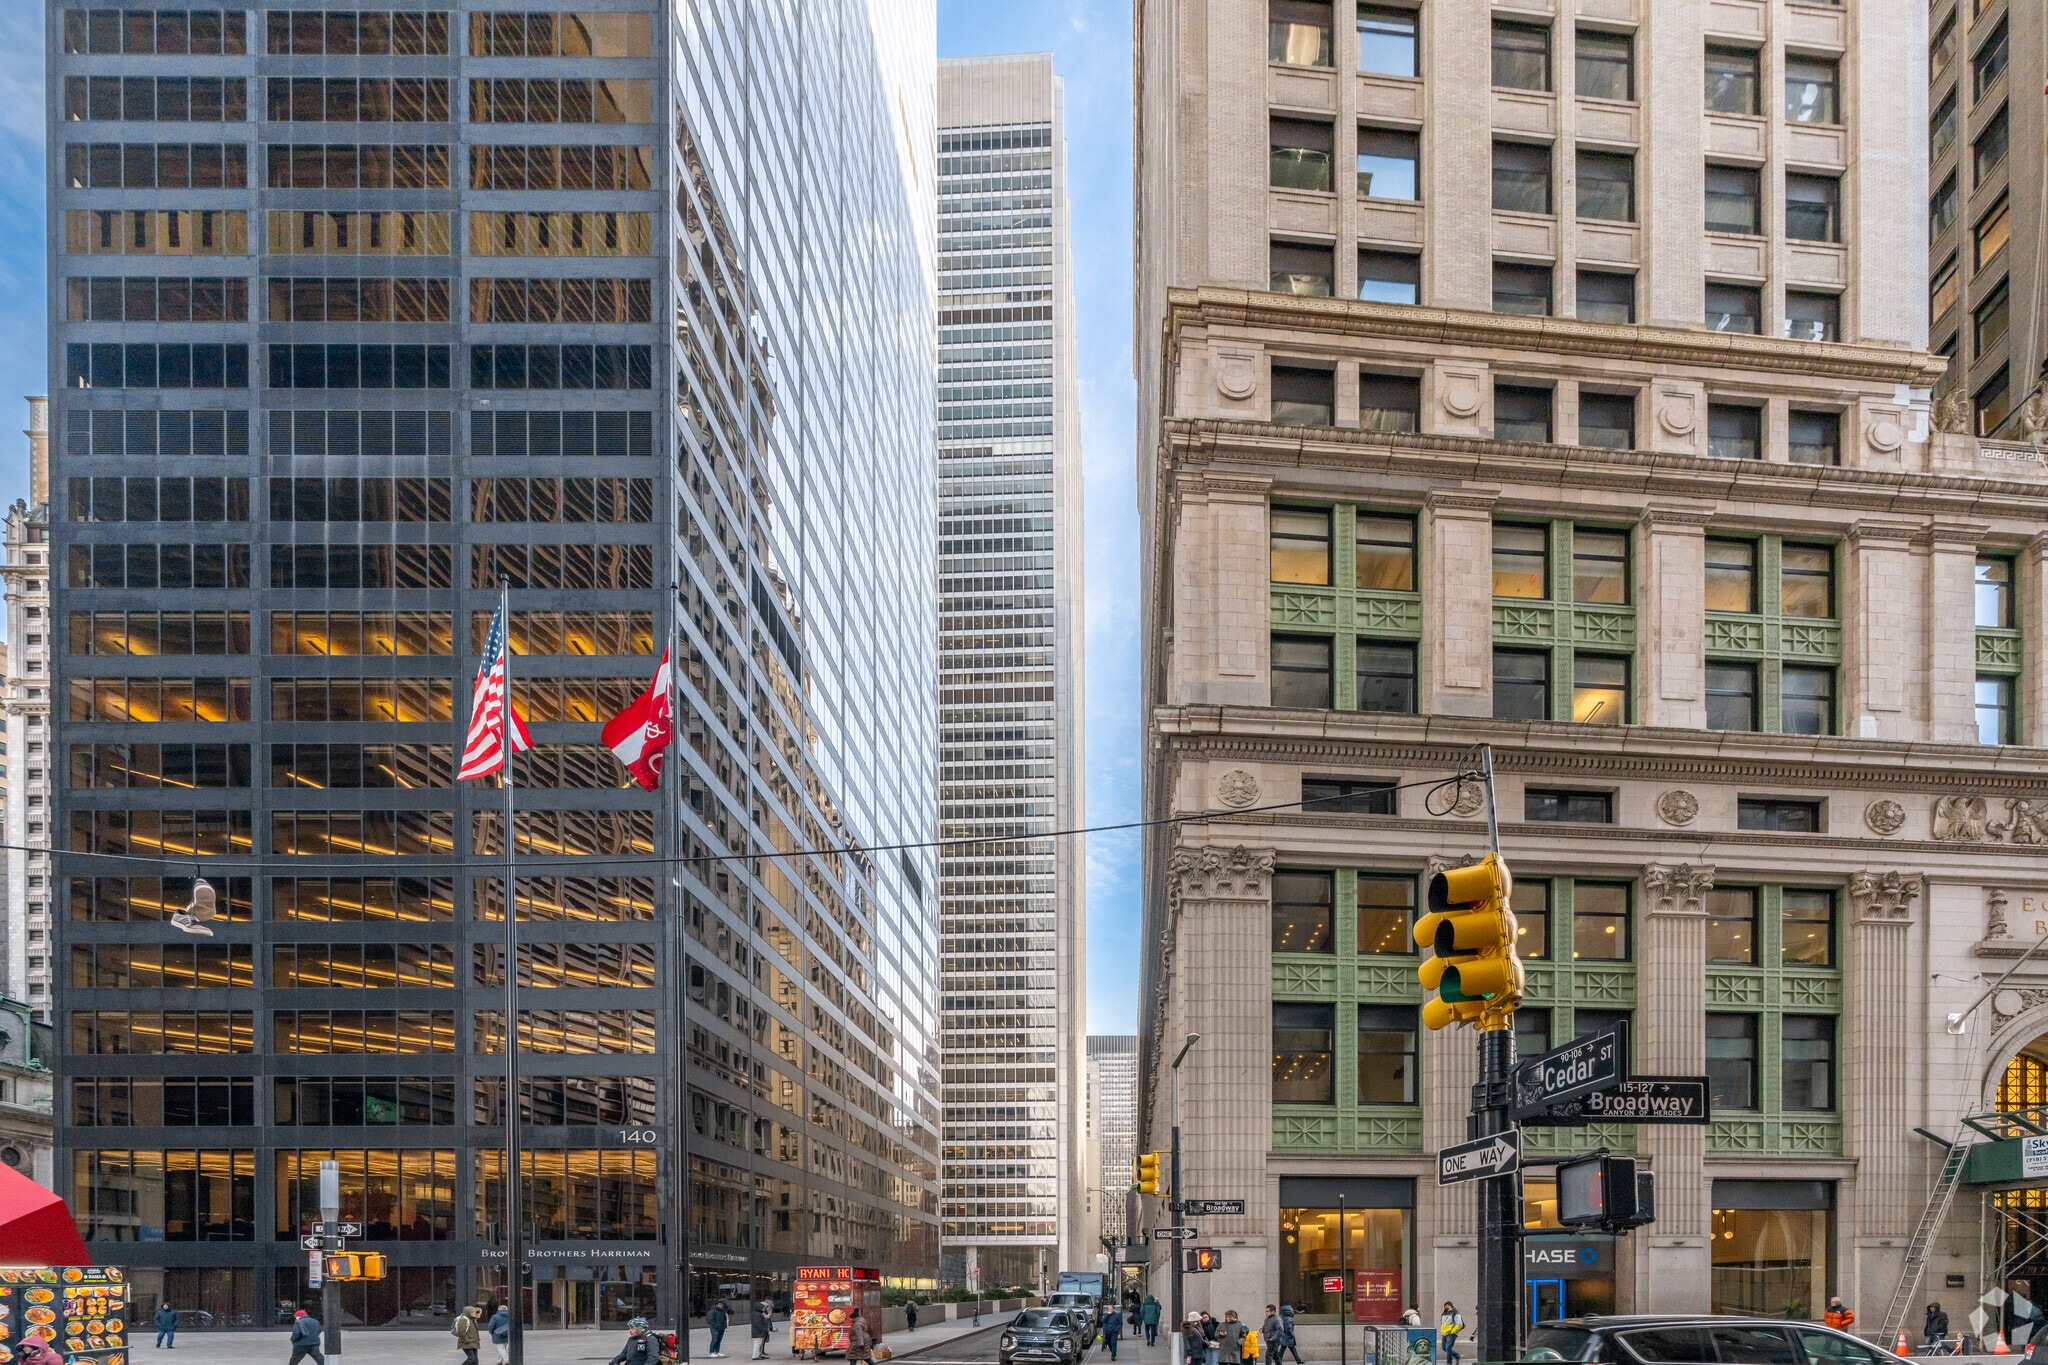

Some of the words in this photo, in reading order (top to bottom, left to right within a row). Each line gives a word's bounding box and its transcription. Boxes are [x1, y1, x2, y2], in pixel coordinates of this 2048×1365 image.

[1560, 1048, 1583, 1063] 90-106
[1545, 1057, 1596, 1092] Cedar
[1600, 1044, 1613, 1062] ST
[1619, 1083, 1654, 1093] 115-127
[1591, 1092, 1694, 1115] Broadway
[620, 1130, 656, 1143] 140
[1445, 1155, 1467, 1173] ONE
[1480, 1146, 1506, 1166] WAY
[1525, 1249, 1577, 1263] HASE
[800, 1269, 830, 1279] RYANI
